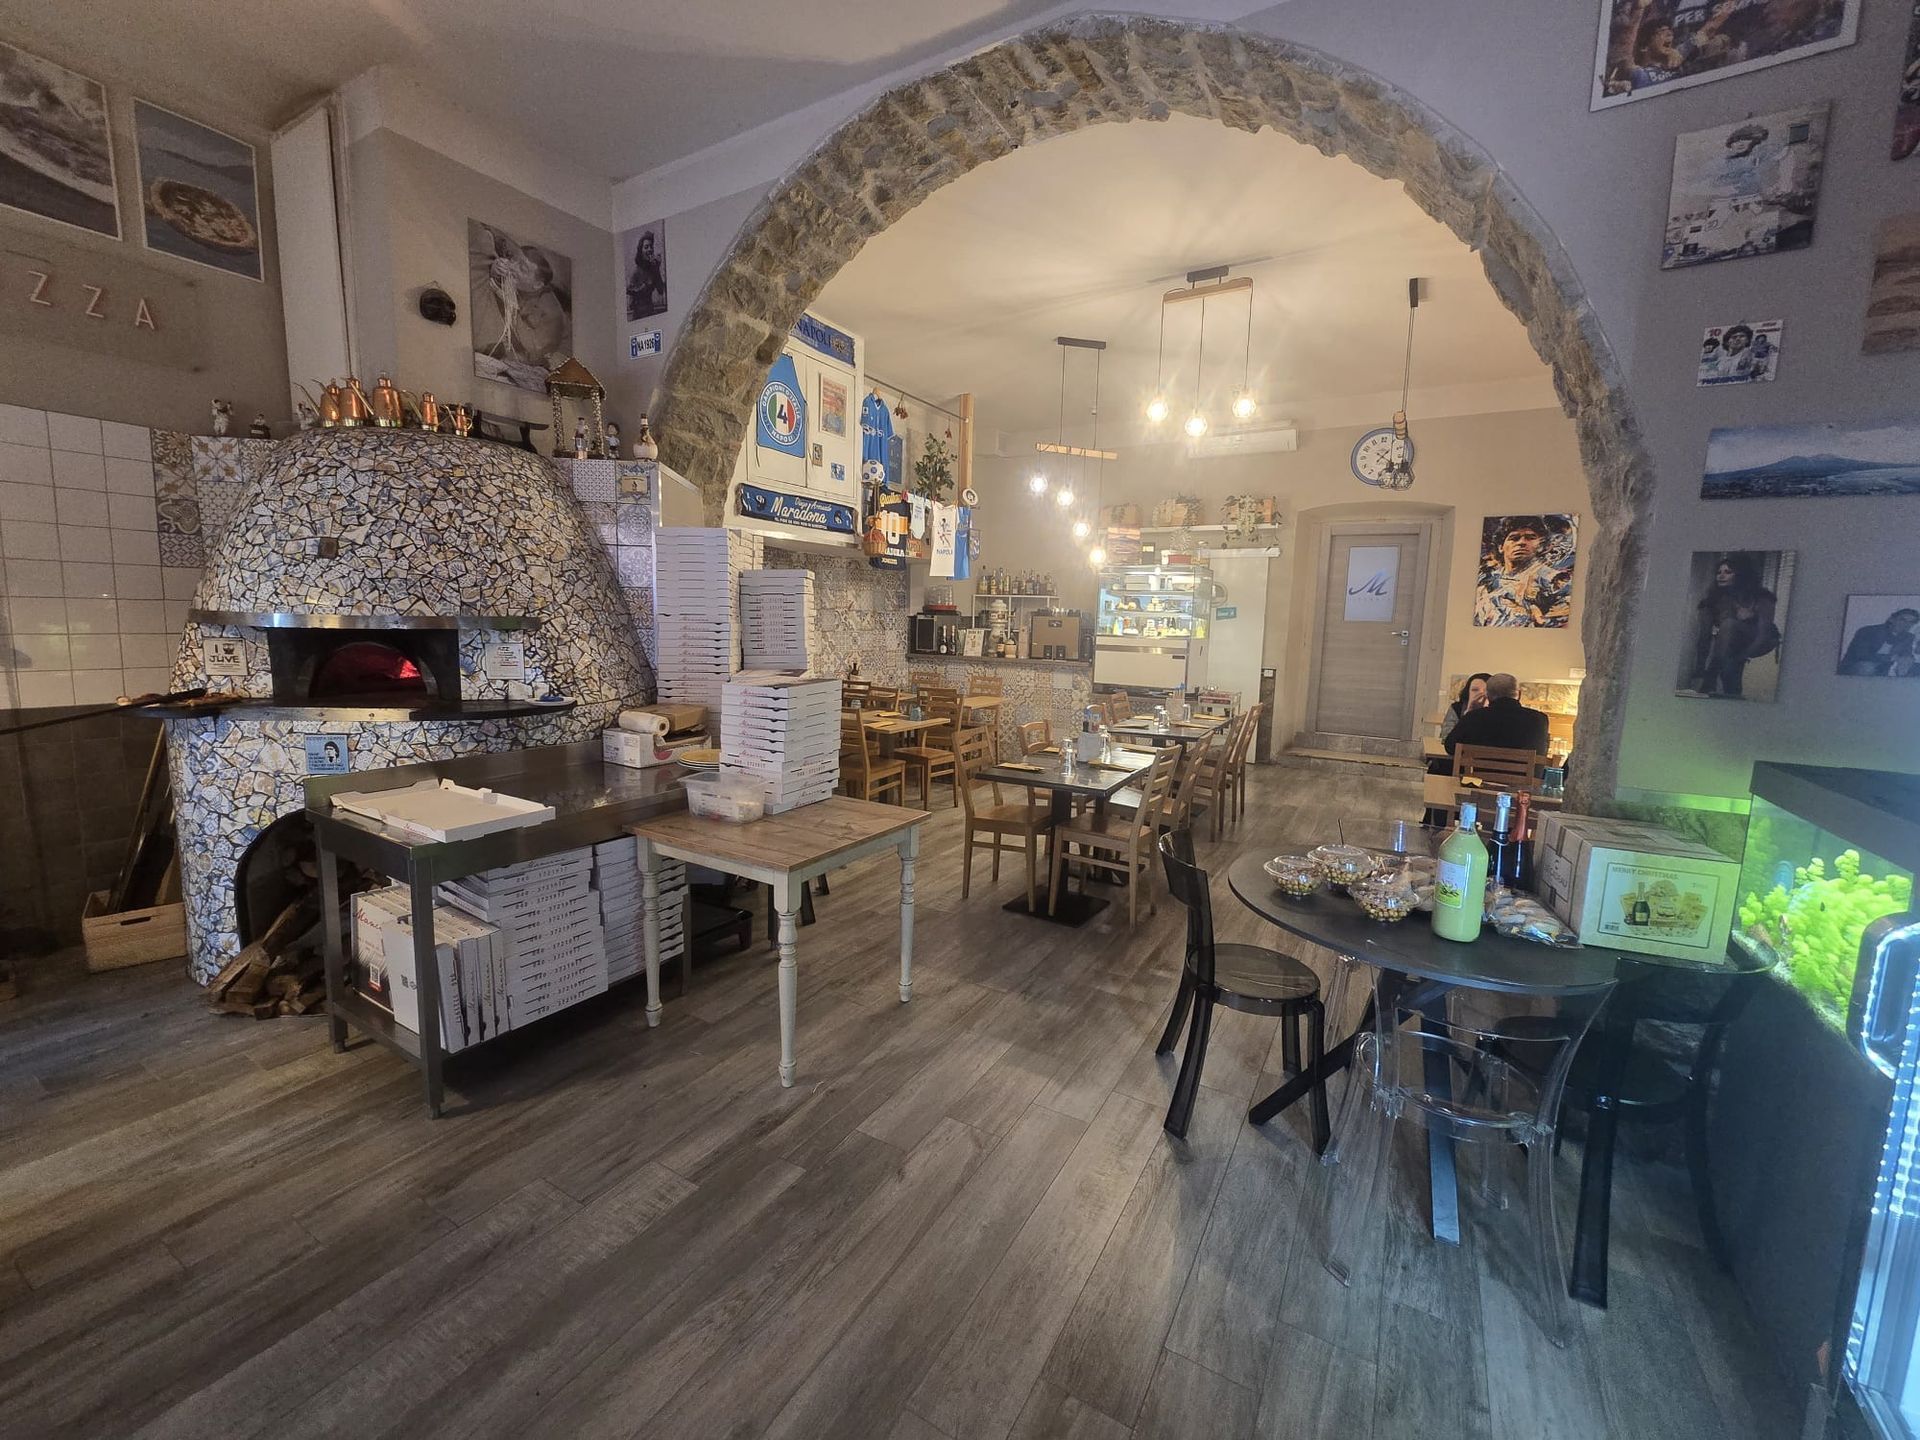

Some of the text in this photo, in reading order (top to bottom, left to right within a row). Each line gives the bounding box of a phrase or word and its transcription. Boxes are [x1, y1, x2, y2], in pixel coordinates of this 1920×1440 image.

[796, 320, 831, 348] NAPOLI
[762, 384, 786, 407] CAMPIONI
[777, 404, 788, 424] 4
[771, 429, 795, 442] NAPOLI
[770, 496, 828, 524] Maradona
[936, 547, 953, 556] NAPOLI
[208, 655, 241, 664] JUVE
[1612, 866, 1637, 875] MERRY
